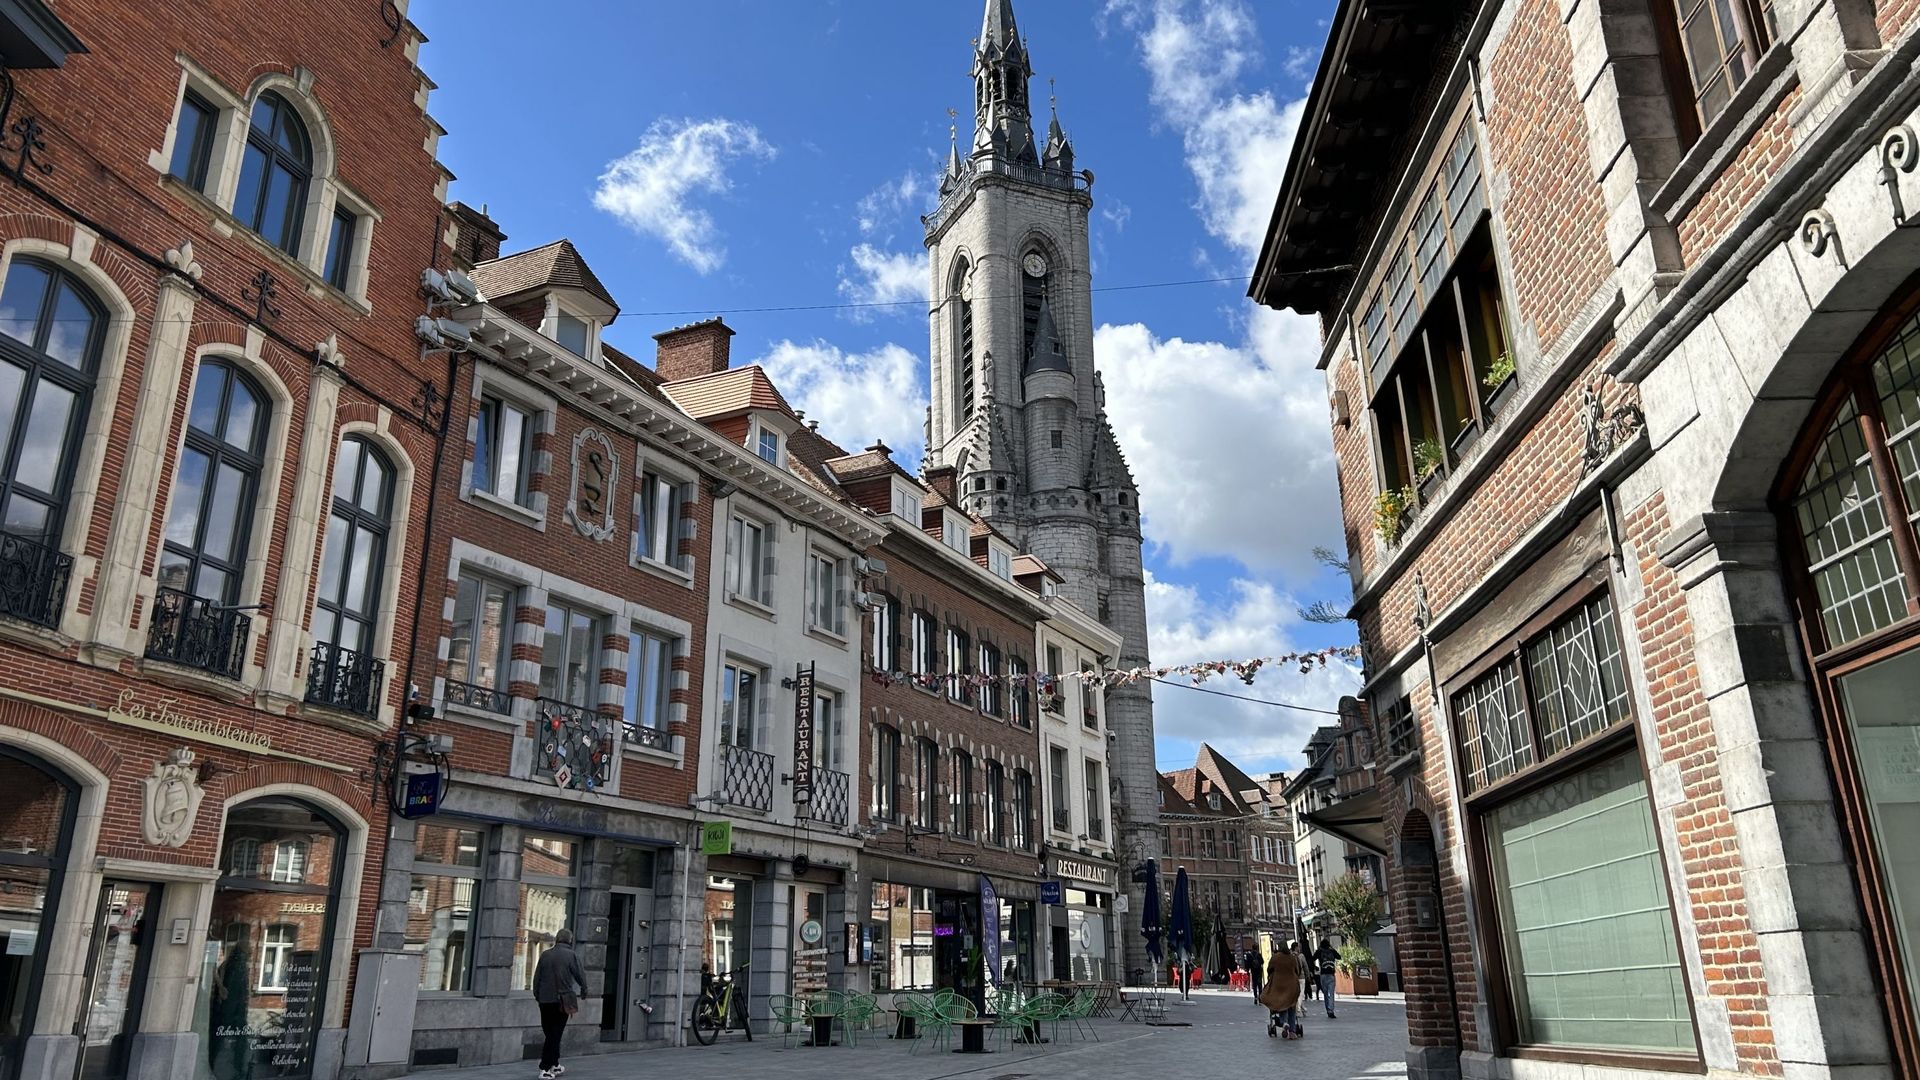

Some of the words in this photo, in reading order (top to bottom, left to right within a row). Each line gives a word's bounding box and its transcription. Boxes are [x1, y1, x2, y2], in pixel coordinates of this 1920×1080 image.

[109, 687, 146, 719] Les
[797, 677, 810, 781] RESTAURANT
[409, 795, 433, 805] BRAC
[1056, 859, 1107, 884] RESTAURANT
